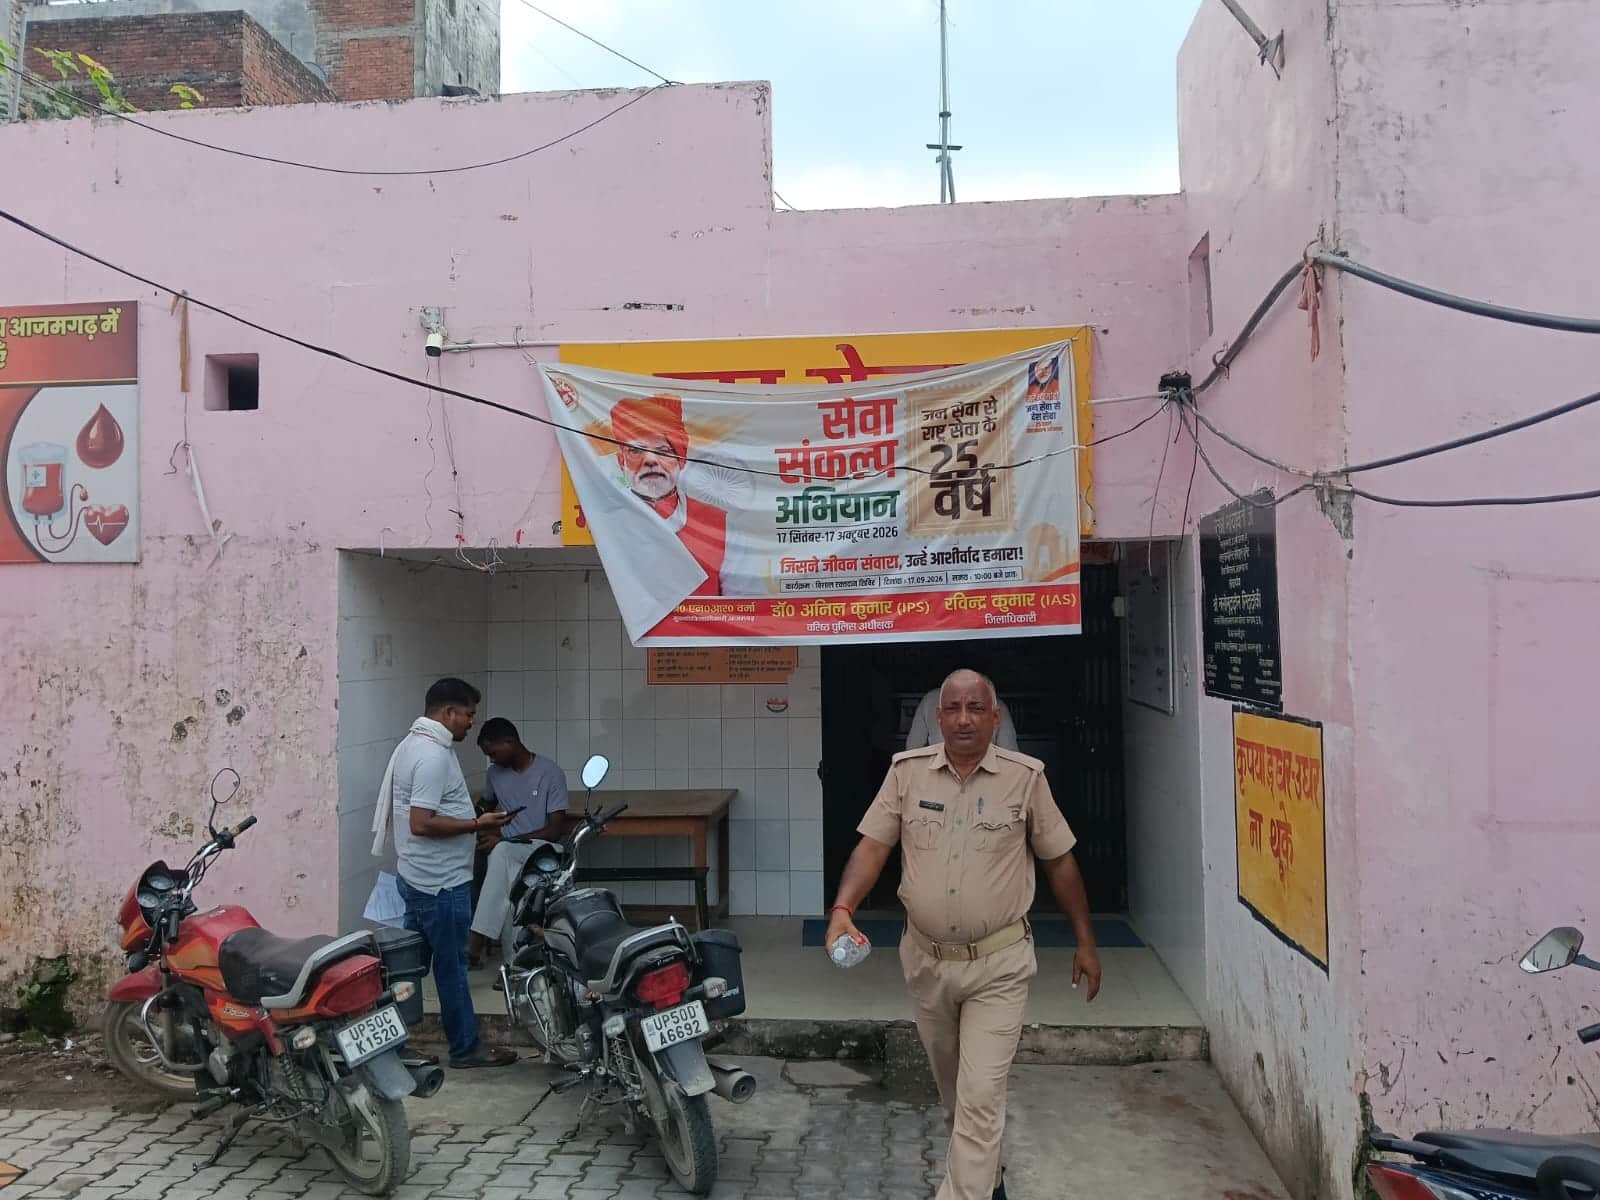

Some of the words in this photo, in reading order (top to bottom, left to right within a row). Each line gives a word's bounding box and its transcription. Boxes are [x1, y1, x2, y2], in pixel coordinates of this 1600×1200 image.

[9, 314, 98, 341] आजमगढ़
[100, 307, 121, 335] में
[818, 397, 898, 440] सेवा
[921, 408, 947, 420] जन
[951, 402, 980, 418] सेवा
[982, 395, 998, 415] से
[949, 419, 979, 438] सेवा
[982, 416, 997, 432] के
[774, 439, 899, 484] संकल्प
[930, 439, 978, 480] 25
[776, 486, 900, 524] अभियान
[929, 463, 996, 520] वर्ष
[777, 532, 786, 543] 17
[873, 526, 898, 539] 2026
[780, 555, 819, 574] जिसने
[822, 553, 858, 572] जीवन
[930, 547, 980, 565] आशीर्वाद
[982, 546, 1024, 562] हमारा!
[801, 599, 846, 617] अनिल
[851, 600, 893, 620] कुमार
[896, 600, 929, 616] (IPS)
[992, 593, 1035, 613] कुमार
[1040, 592, 1077, 609] (IAS)
[832, 620, 856, 633] पुलिस
[985, 611, 1037, 625] जिलाधिकारी
[349, 1012, 391, 1040] UP50C
[653, 1005, 696, 1030] UP50D
[356, 1024, 399, 1055] K1520
[660, 1020, 701, 1046] A6692
